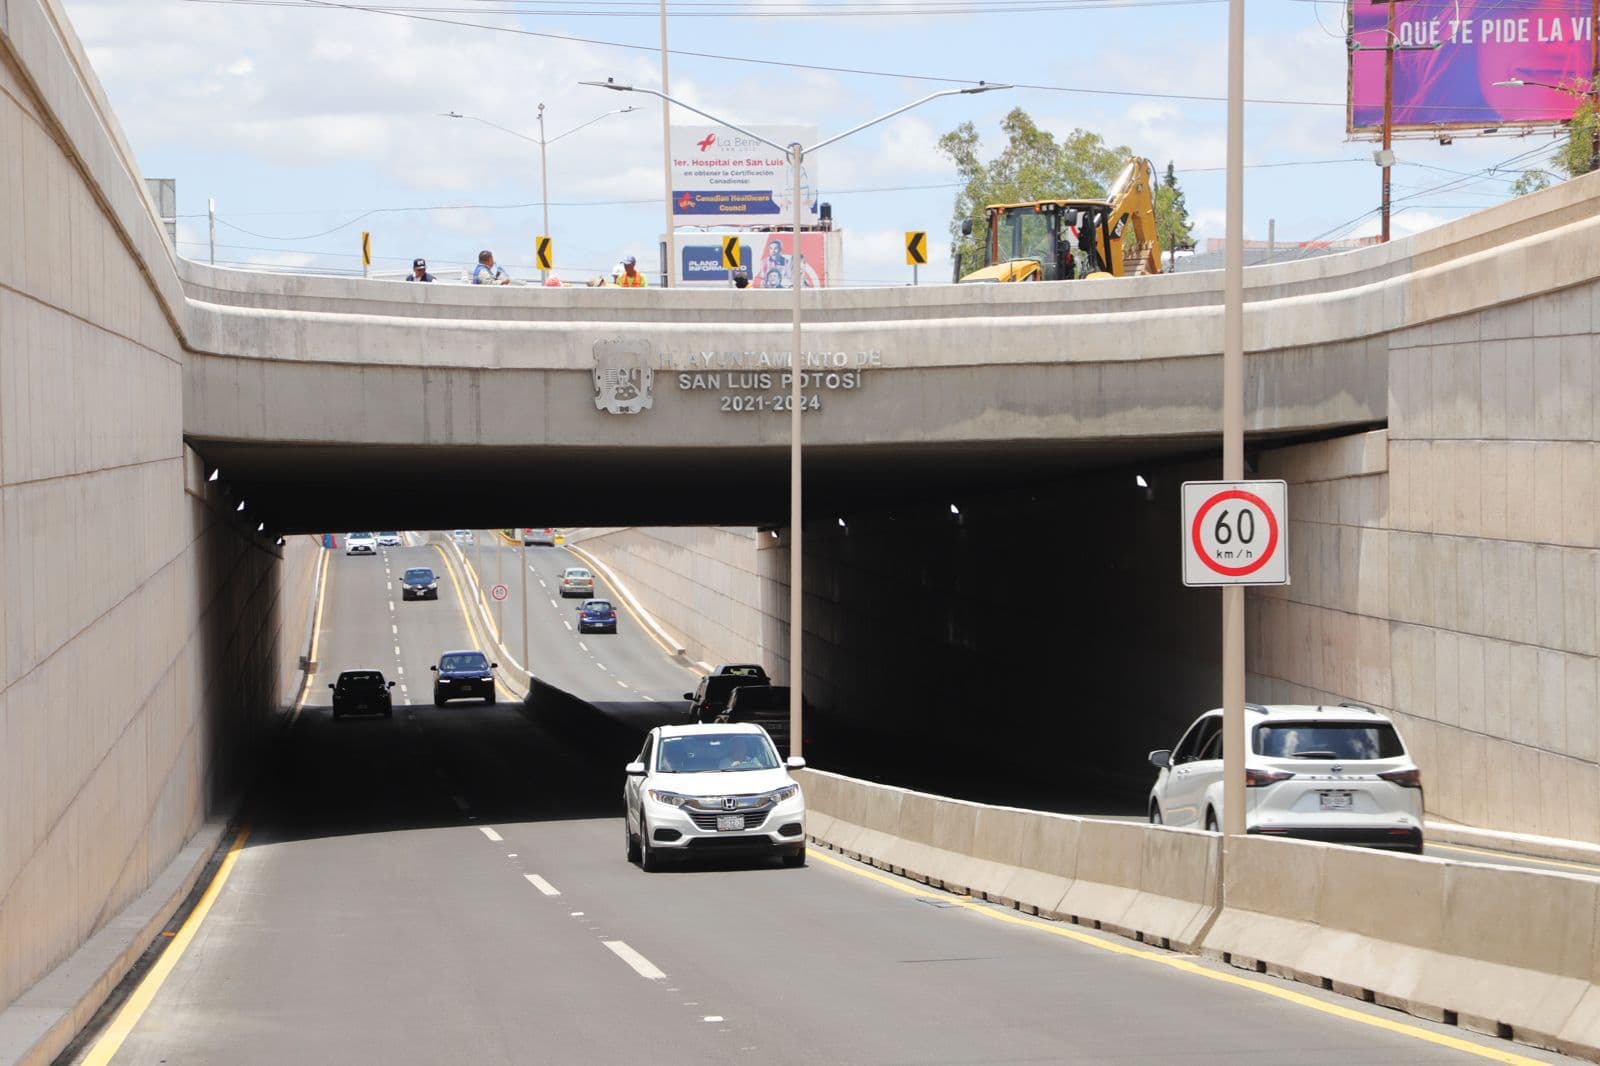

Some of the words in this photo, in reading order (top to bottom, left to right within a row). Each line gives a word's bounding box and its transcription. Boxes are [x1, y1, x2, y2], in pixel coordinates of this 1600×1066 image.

[1400, 16, 1440, 45] QUÉ
[1448, 20, 1473, 44] TE
[1481, 18, 1529, 43] PIDE
[1538, 17, 1563, 41] LA
[1571, 16, 1600, 41] VI
[717, 137, 731, 147] La
[692, 159, 730, 168] Hospital
[745, 159, 763, 167] San
[730, 169, 774, 177] Certificación
[720, 204, 747, 212] Council
[856, 350, 881, 366] DE
[679, 373, 720, 390] SAN
[727, 372, 772, 389] LUIS
[781, 368, 861, 389] POTOSÍ
[720, 394, 821, 411] 2021-2024
[1215, 508, 1255, 545] 60
[1216, 549, 1253, 559] km/h
